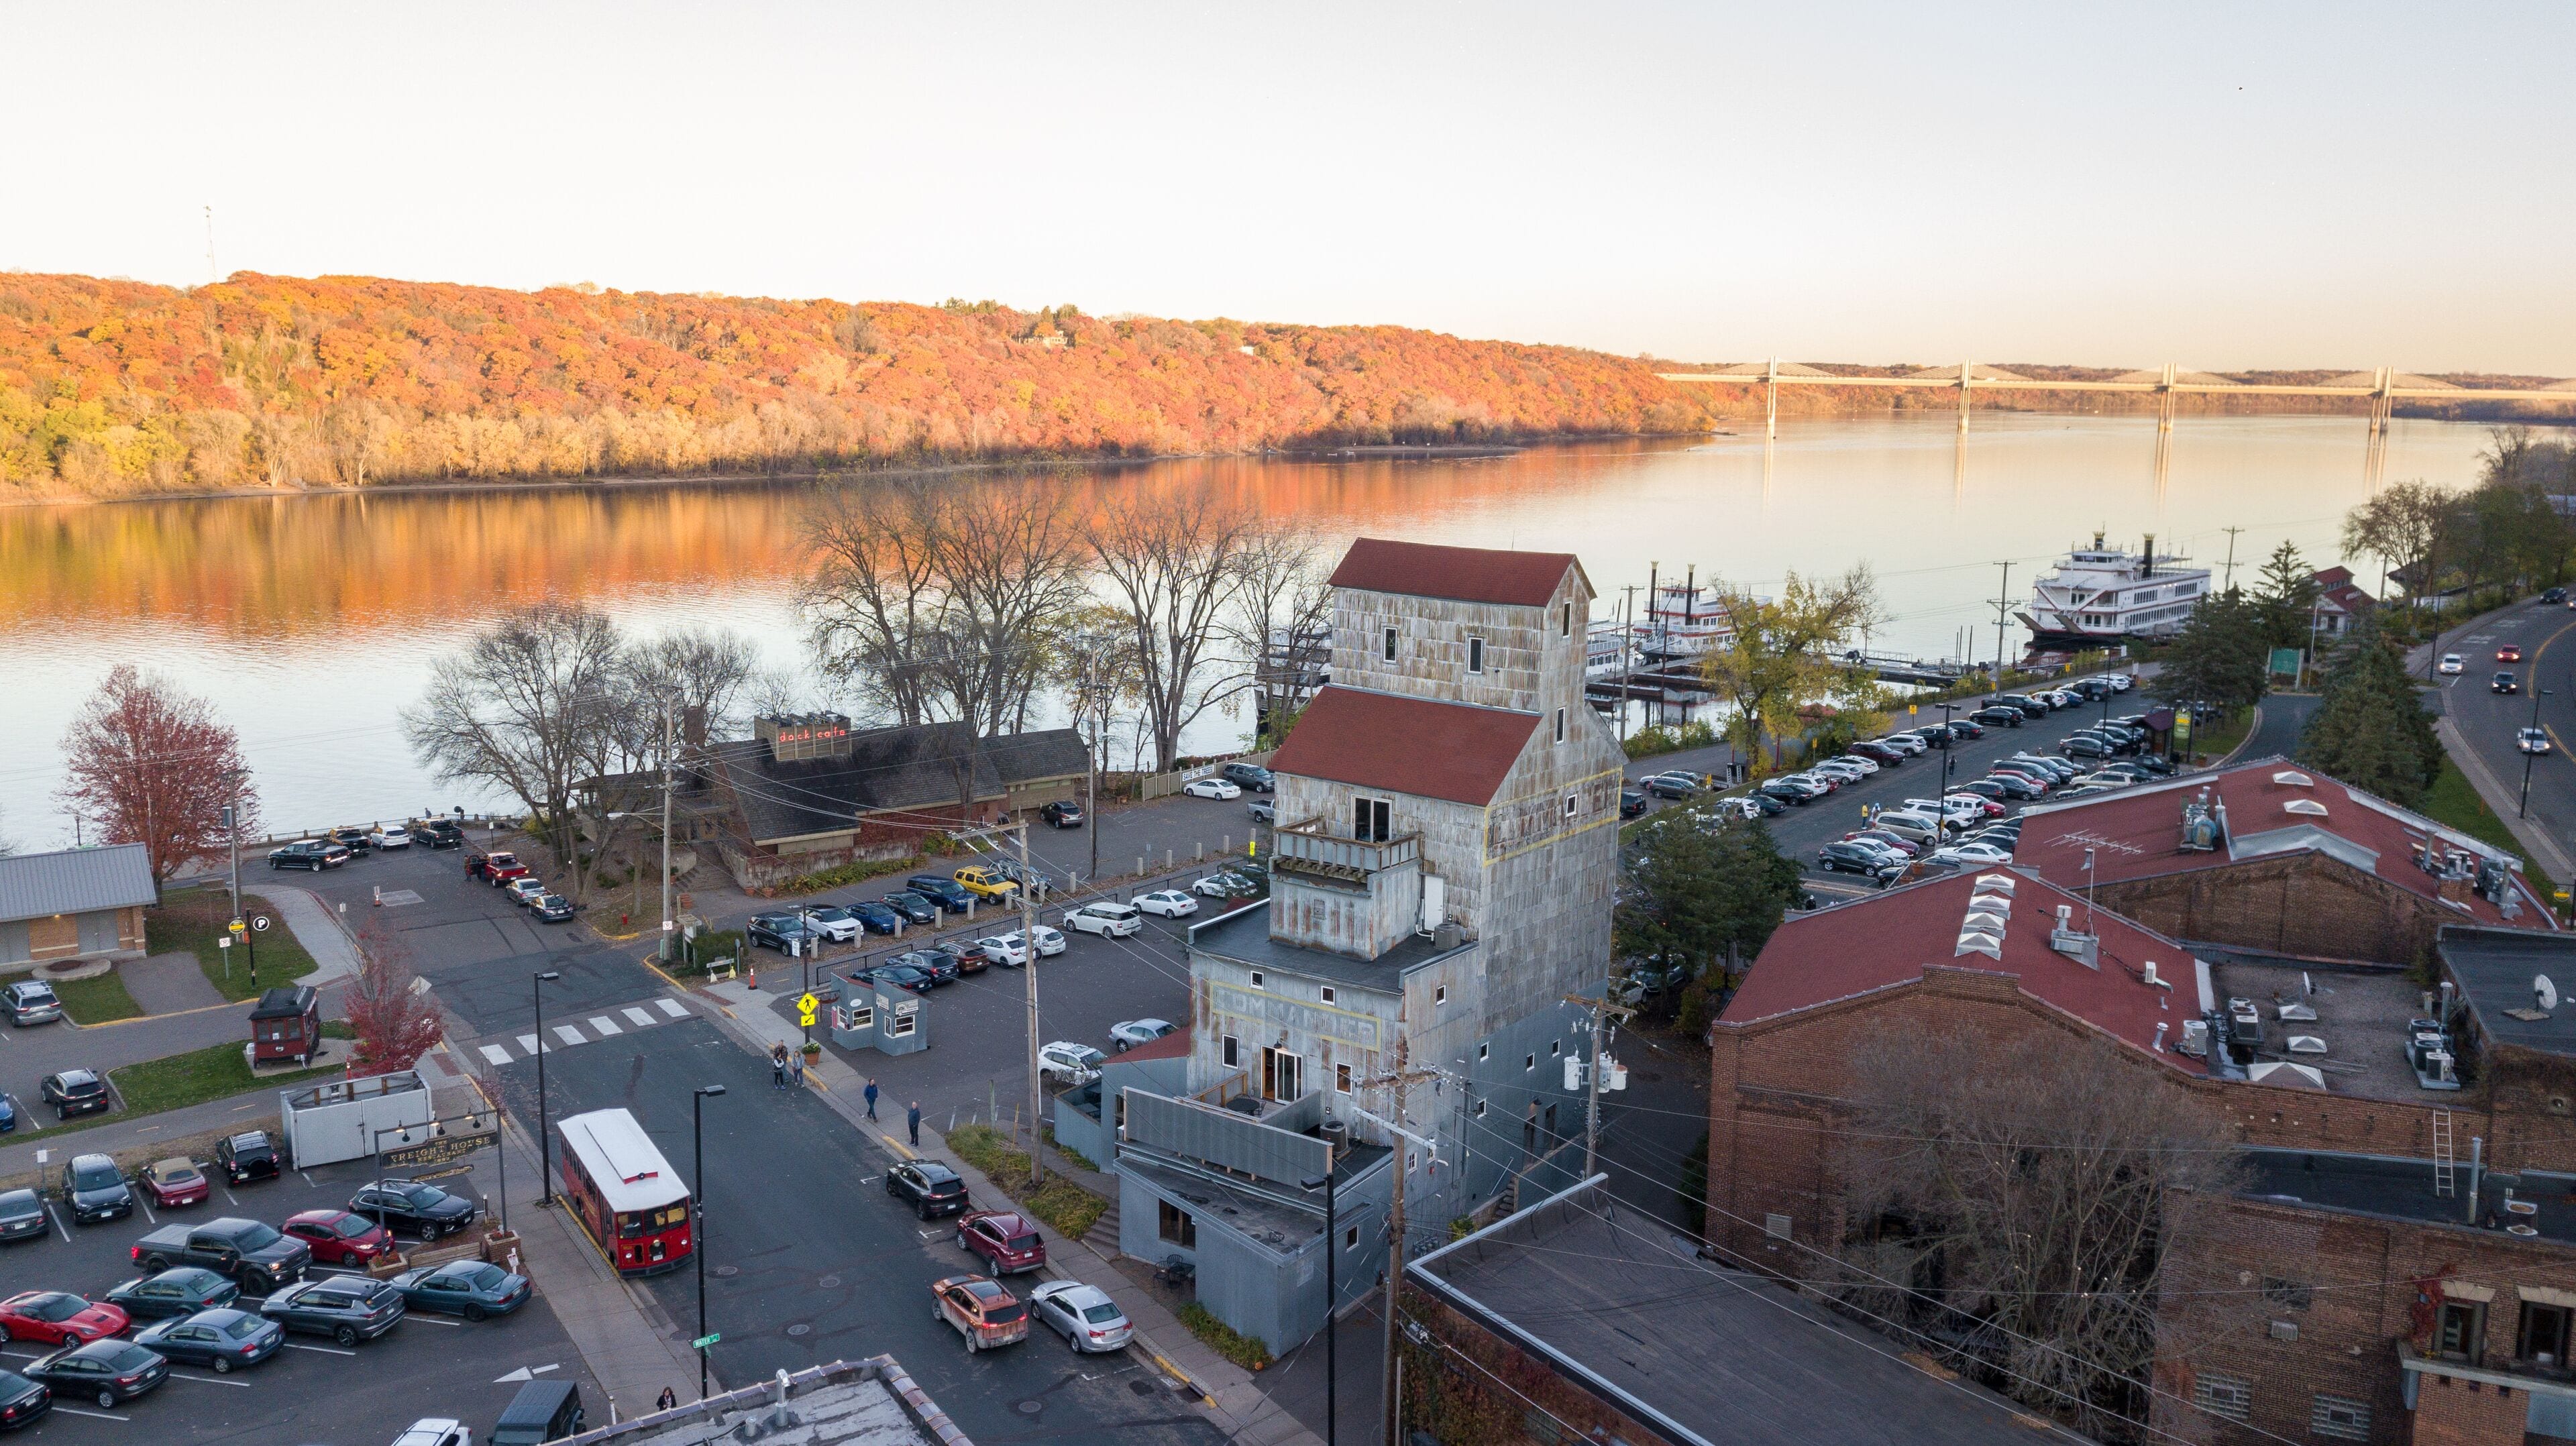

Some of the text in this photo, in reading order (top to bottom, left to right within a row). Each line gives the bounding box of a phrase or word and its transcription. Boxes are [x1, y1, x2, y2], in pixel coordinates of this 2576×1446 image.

[780, 726, 845, 742] dock cafe
[258, 920, 266, 928] P
[390, 1137, 490, 1162] FREIGHT HOUSE
[695, 1337, 710, 1347] WATER
